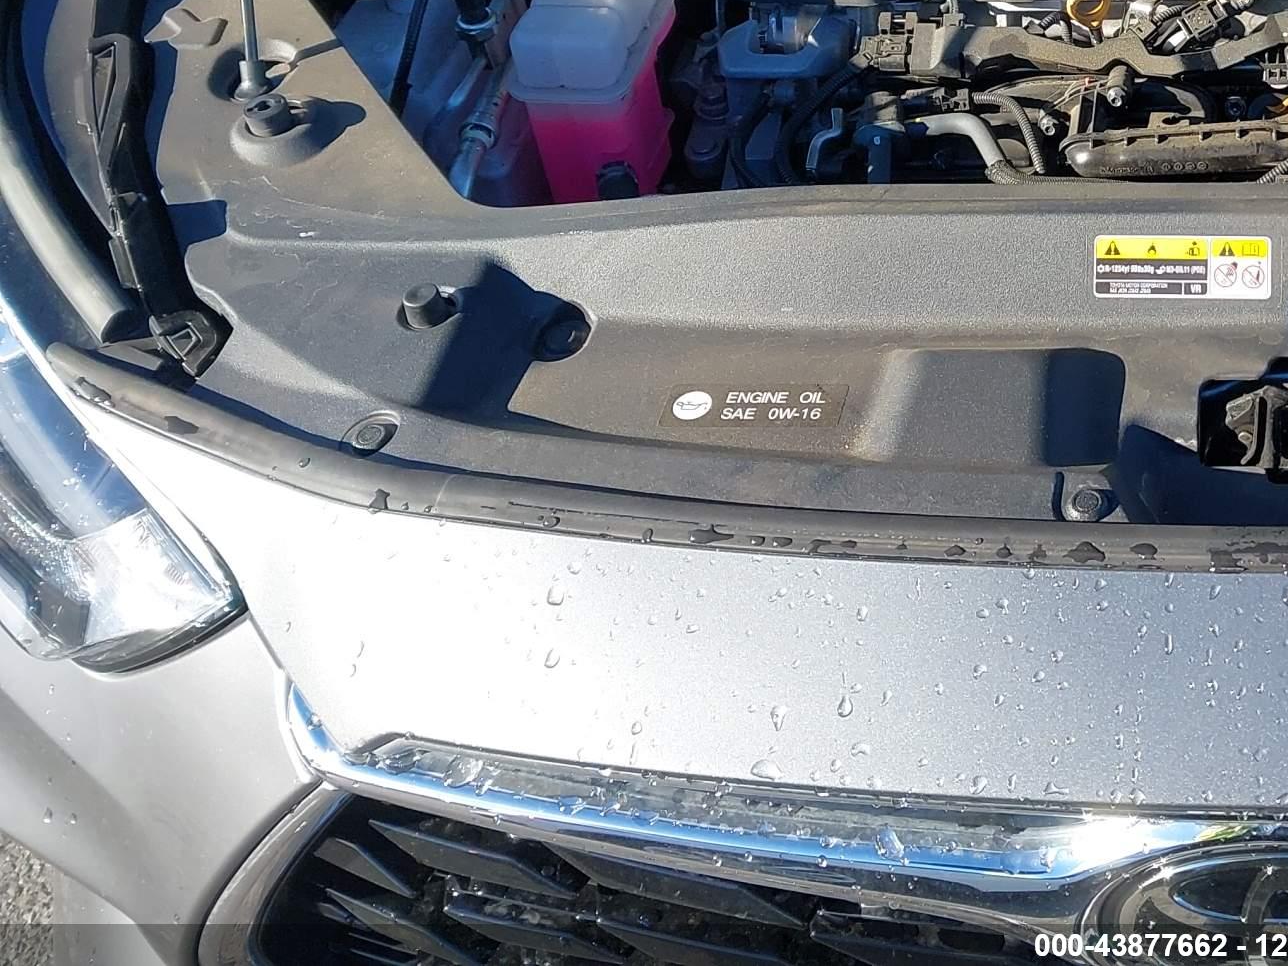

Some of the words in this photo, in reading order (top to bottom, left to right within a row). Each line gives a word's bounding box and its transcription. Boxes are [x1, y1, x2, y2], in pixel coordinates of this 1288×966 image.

[1190, 284, 1202, 294] VR
[726, 391, 788, 404] ENGINE
[799, 391, 826, 404] OIL
[720, 408, 757, 420] SAE
[768, 408, 821, 420] 0W-16
